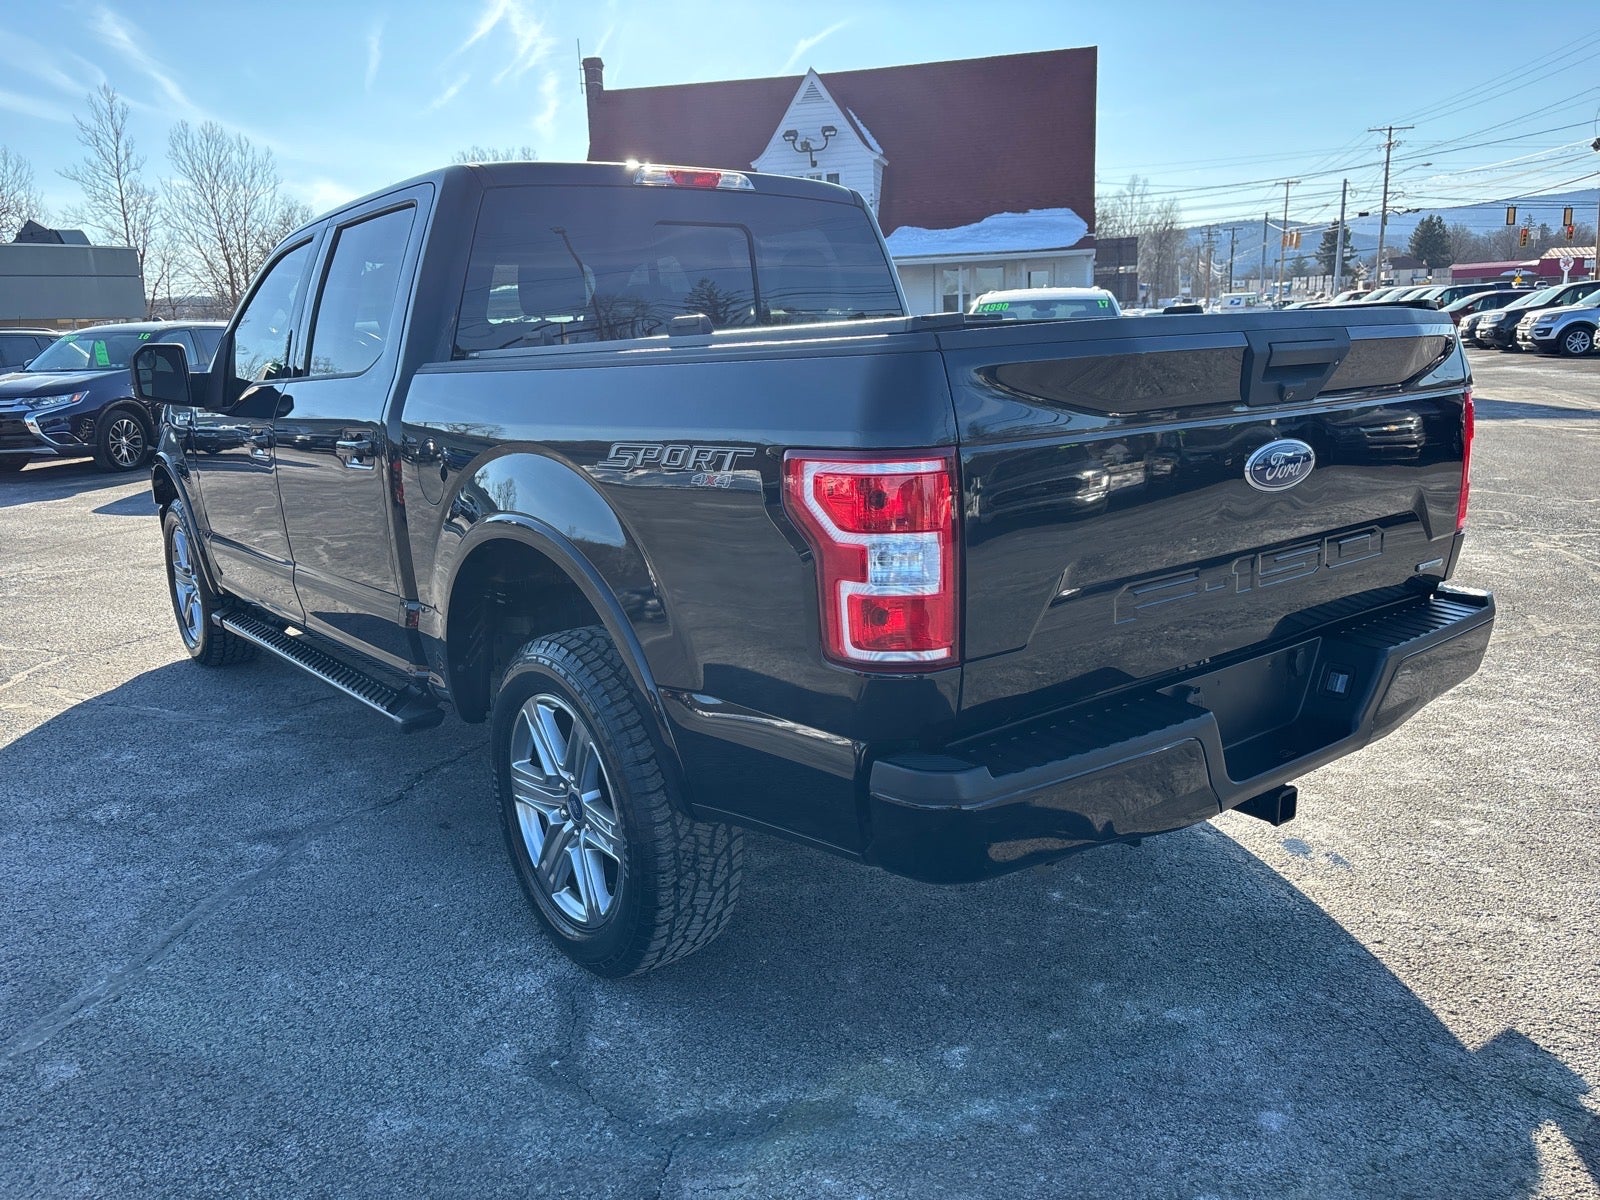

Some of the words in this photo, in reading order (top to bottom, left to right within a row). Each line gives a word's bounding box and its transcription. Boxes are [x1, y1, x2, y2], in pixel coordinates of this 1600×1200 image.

[976, 302, 1009, 313] 14990
[1097, 300, 1109, 308] 17
[138, 332, 151, 340] 16
[596, 442, 757, 472] SPORT
[1265, 451, 1304, 481] Ford
[1113, 524, 1385, 625] F-150
